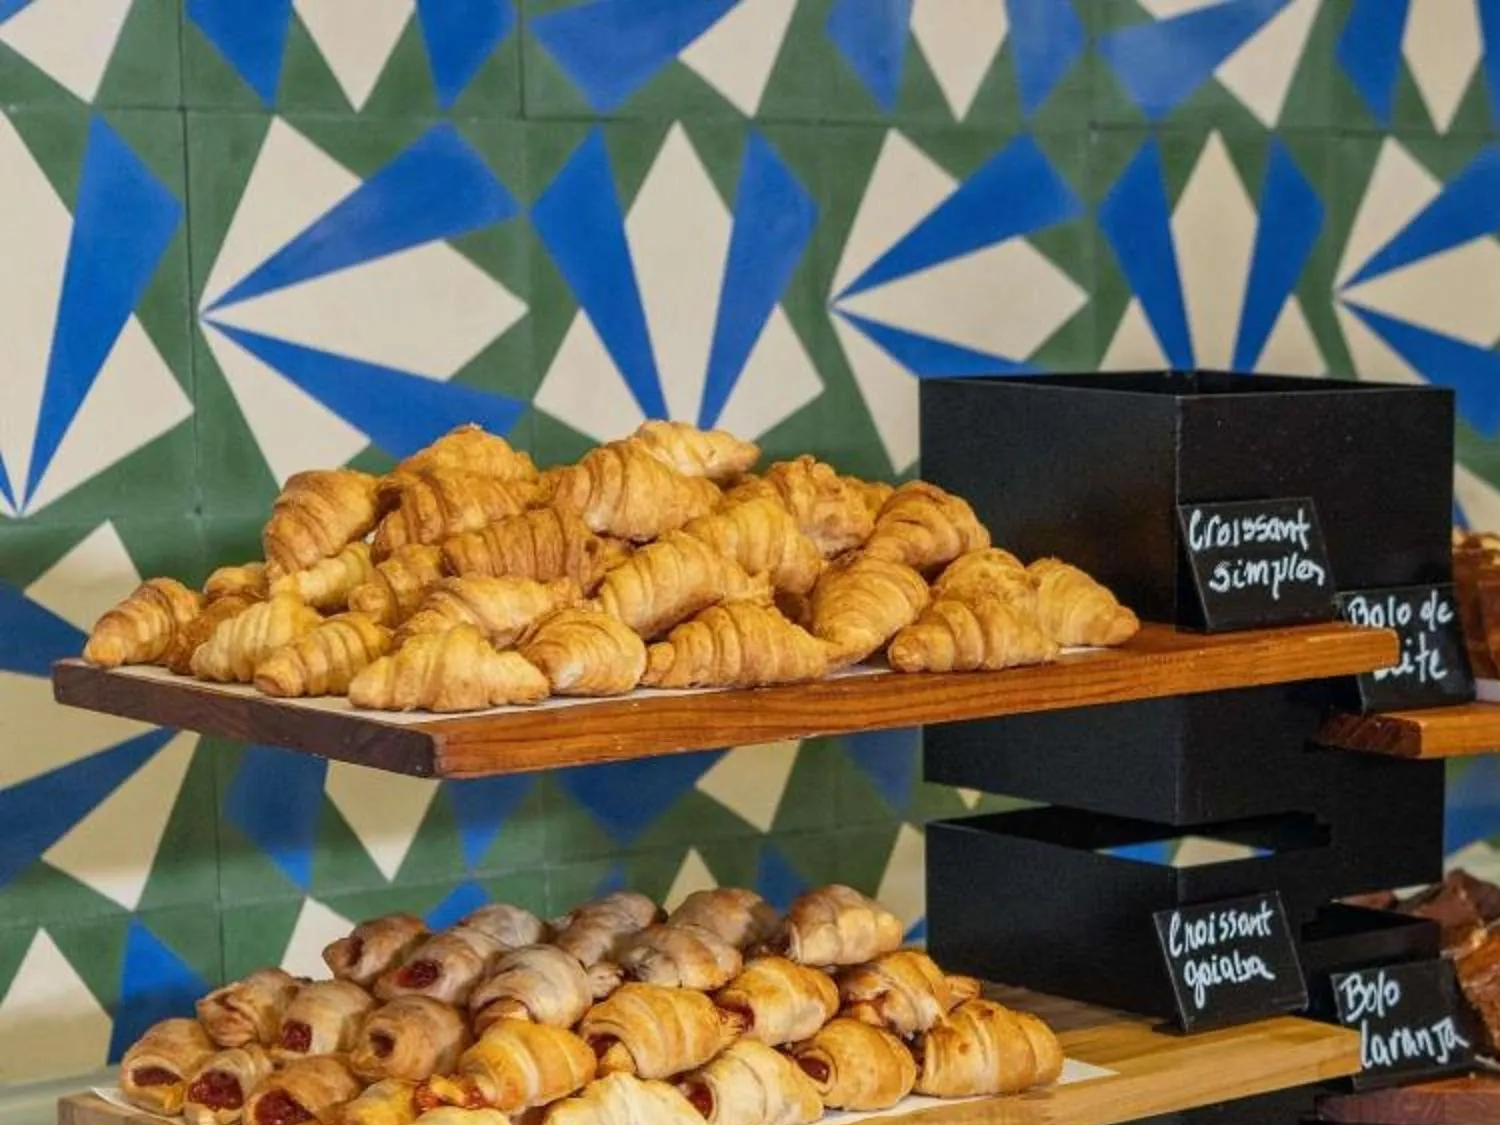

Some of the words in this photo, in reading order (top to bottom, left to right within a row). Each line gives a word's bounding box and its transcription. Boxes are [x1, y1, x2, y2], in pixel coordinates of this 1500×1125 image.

[1189, 508, 1311, 552] Croissant
[1347, 596, 1412, 627] Bolo
[1419, 588, 1454, 631] de
[1371, 631, 1448, 683] ite
[1168, 900, 1275, 958] Croissant
[1183, 950, 1276, 1010] goiaba
[1338, 970, 1401, 1022] Bolo
